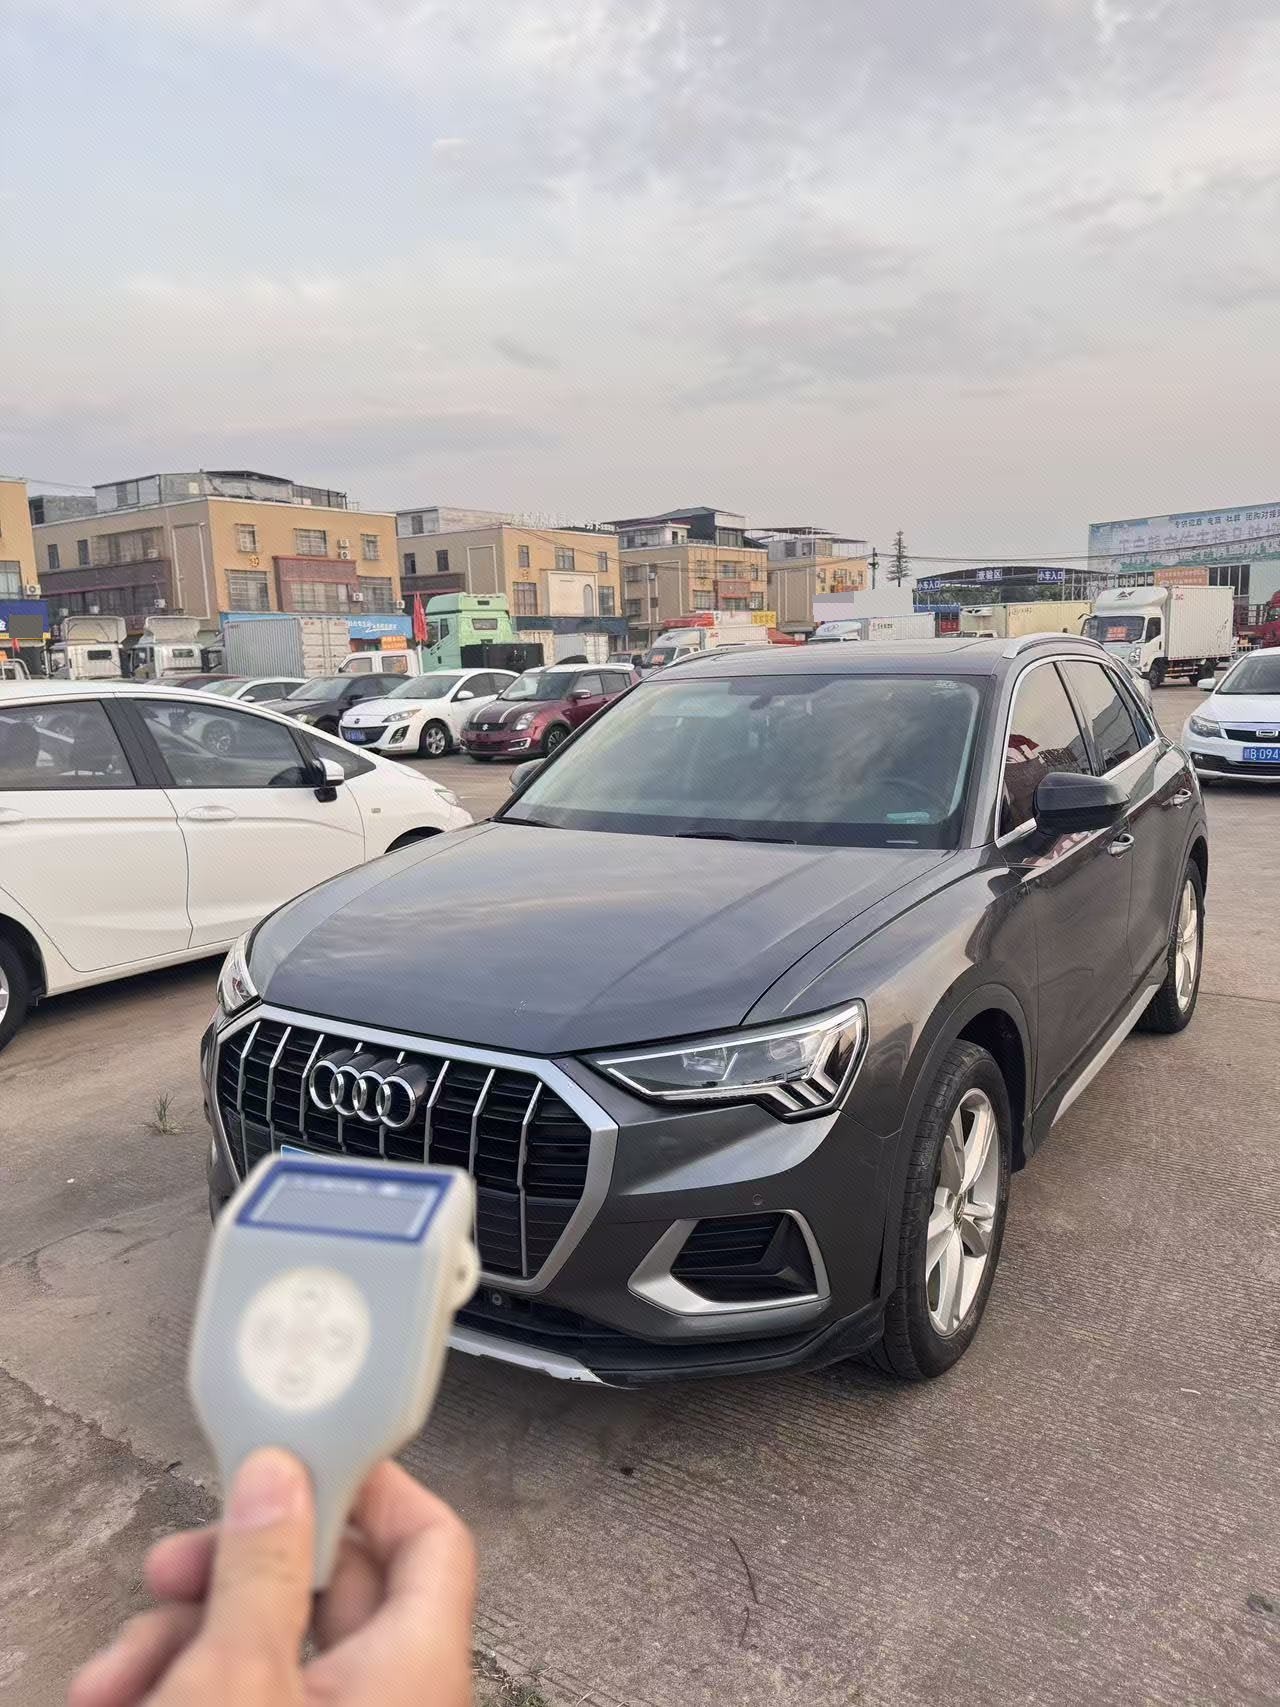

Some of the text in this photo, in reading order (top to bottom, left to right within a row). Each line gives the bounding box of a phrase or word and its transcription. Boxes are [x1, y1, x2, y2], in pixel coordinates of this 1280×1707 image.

[1038, 570, 1064, 581] 小车入口
[917, 580, 940, 590] 小车入口
